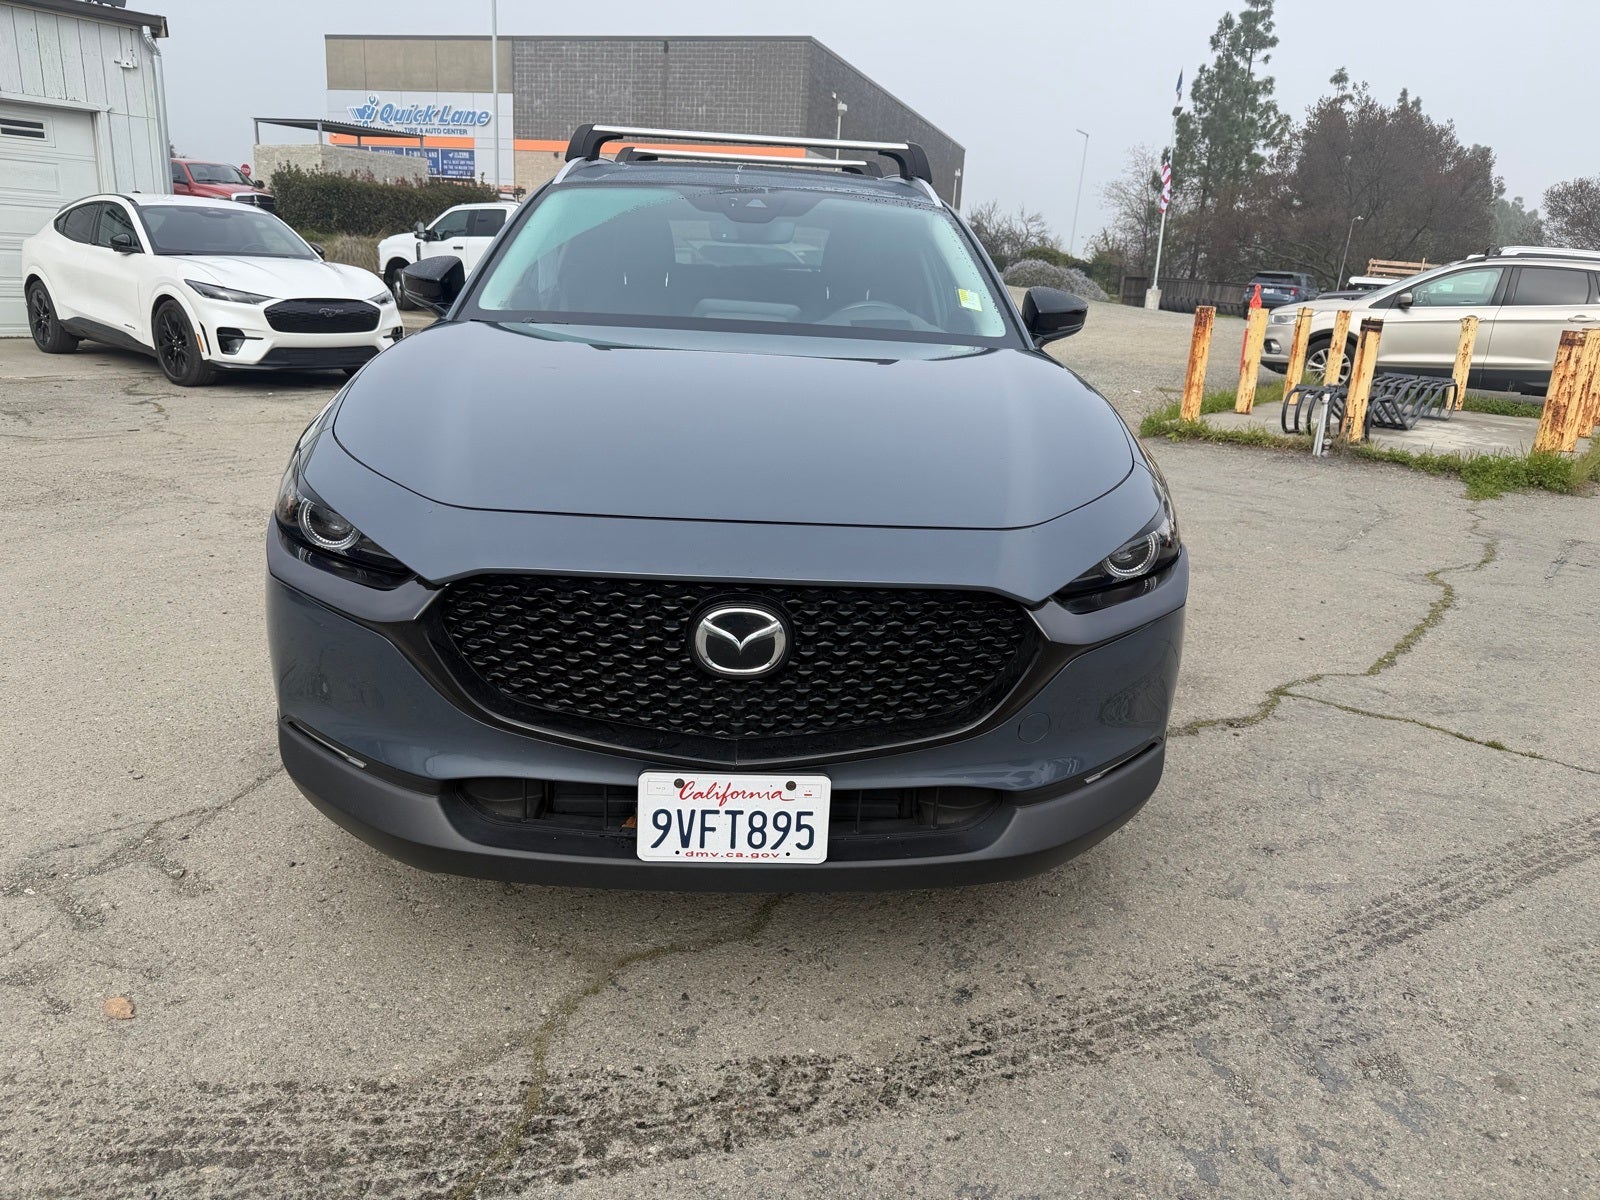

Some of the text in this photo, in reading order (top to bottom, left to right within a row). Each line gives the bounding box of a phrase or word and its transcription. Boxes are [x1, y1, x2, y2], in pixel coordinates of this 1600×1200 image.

[379, 103, 490, 125] Quick Lane
[679, 780, 795, 807] California
[650, 808, 815, 850] 9VFT895
[685, 851, 780, 859] dmv.ca.gov
